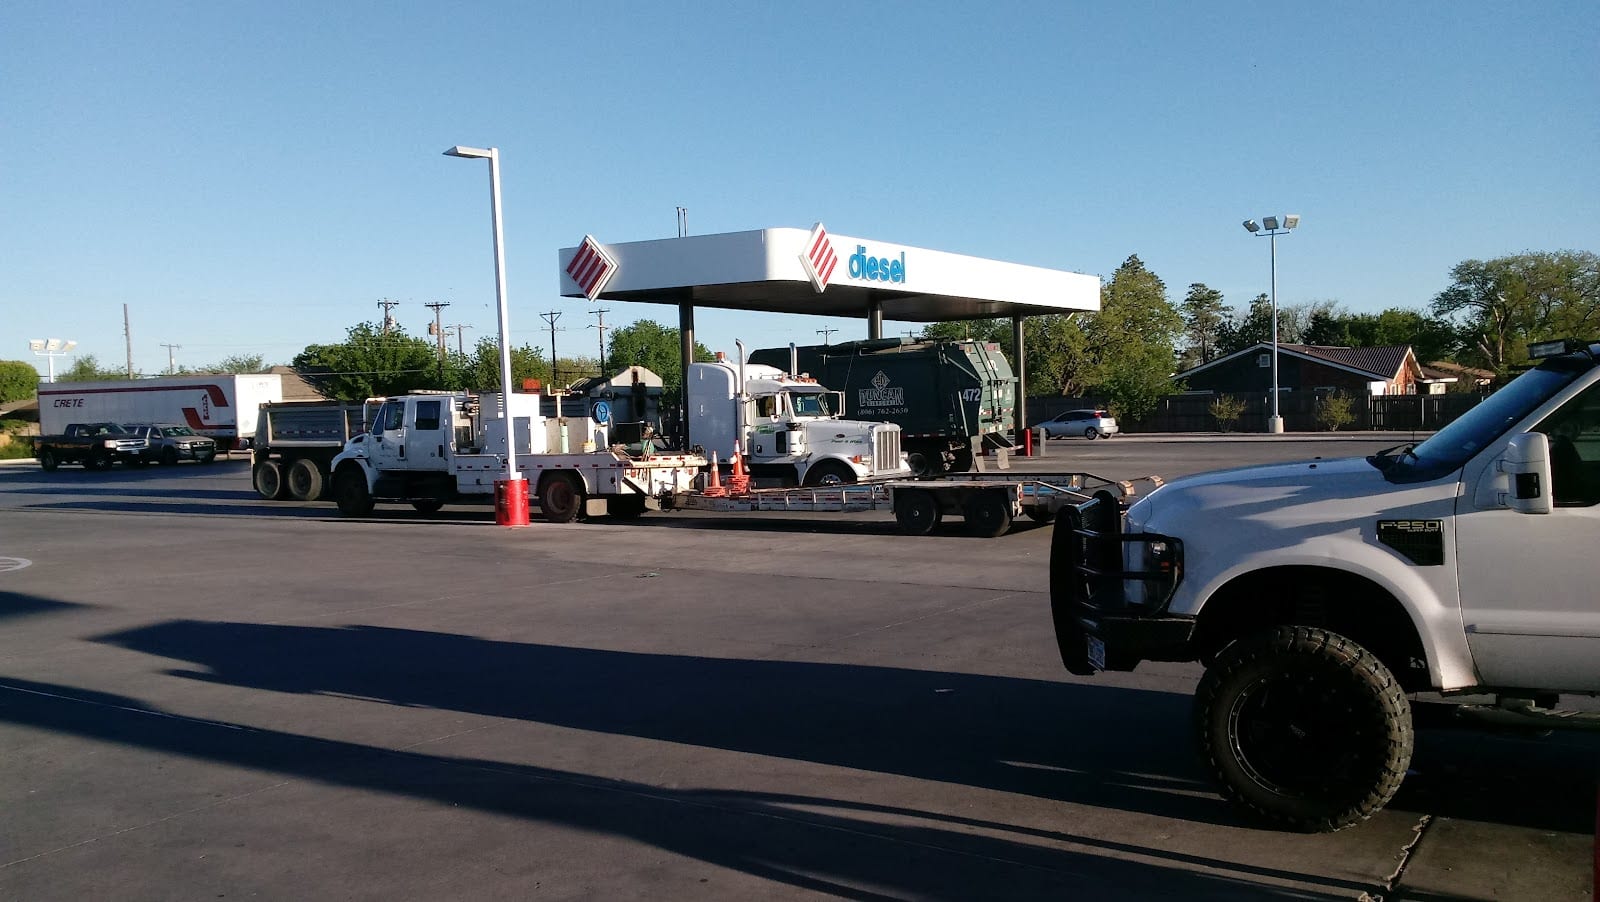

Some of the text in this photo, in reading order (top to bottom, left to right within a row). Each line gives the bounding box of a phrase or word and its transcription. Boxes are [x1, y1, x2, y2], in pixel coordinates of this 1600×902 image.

[848, 244, 905, 283] diesel
[53, 398, 84, 408] CRETE
[859, 387, 904, 407] DUNCAN
[962, 388, 981, 402] 472
